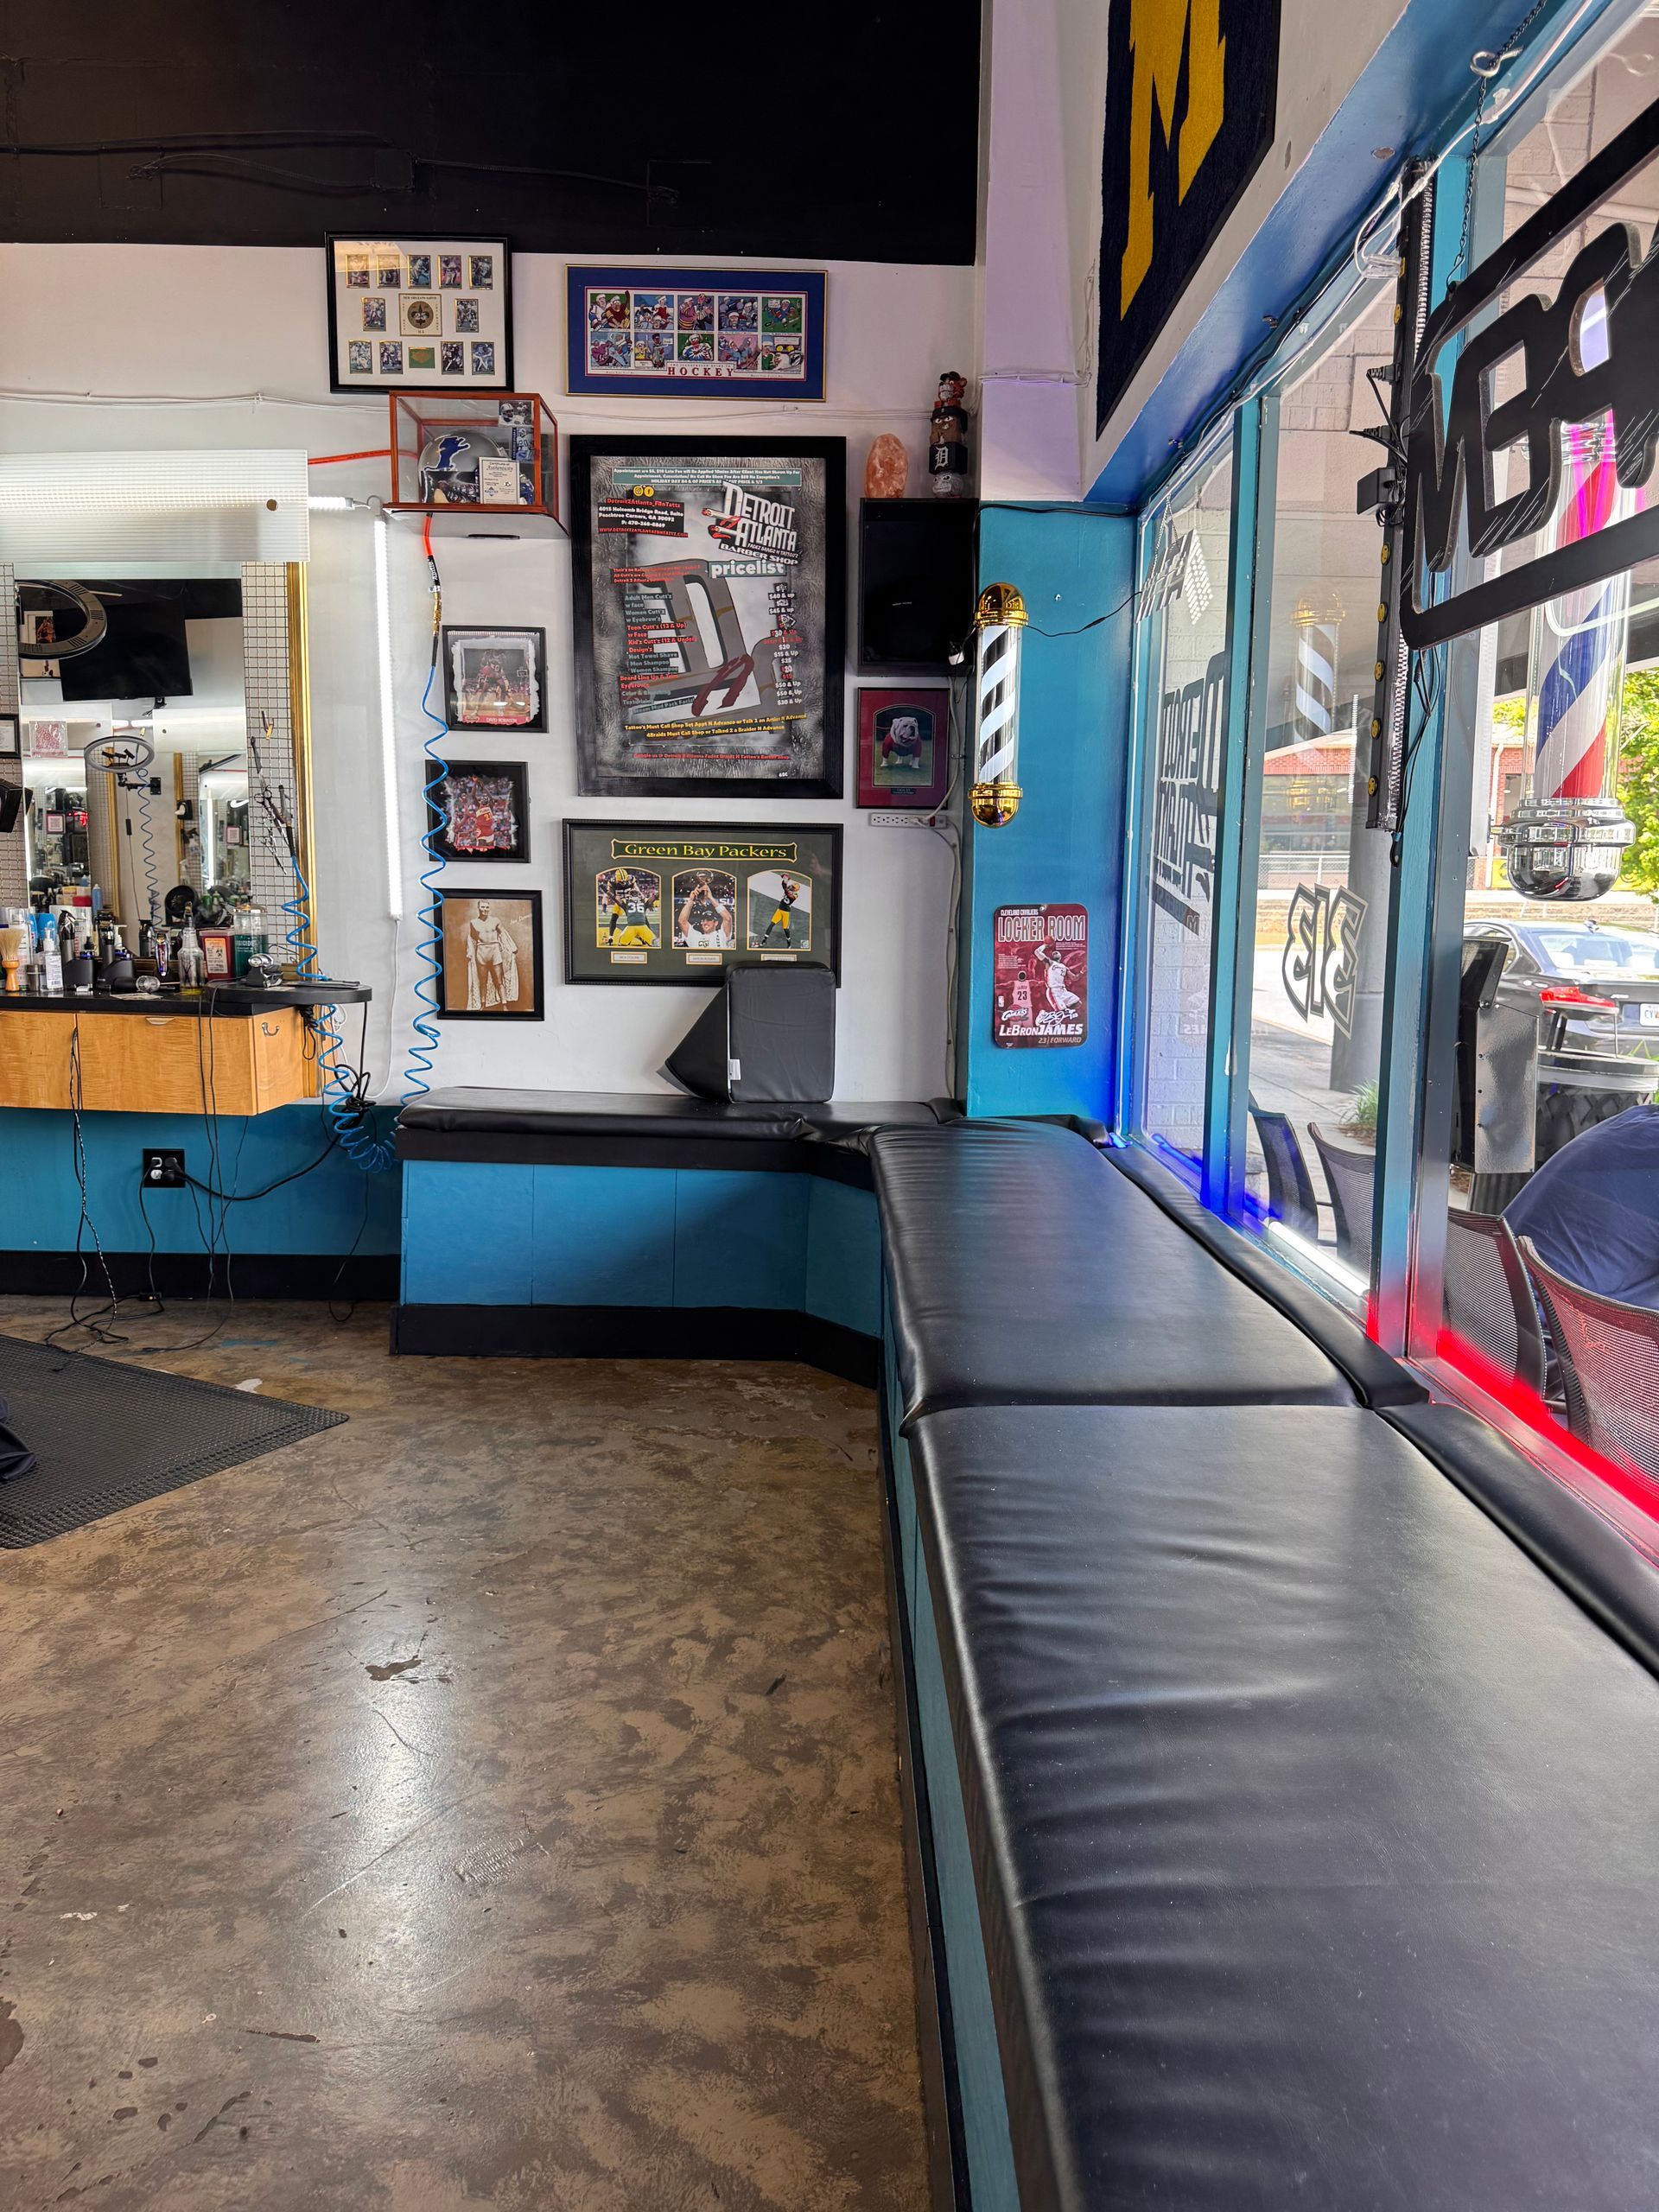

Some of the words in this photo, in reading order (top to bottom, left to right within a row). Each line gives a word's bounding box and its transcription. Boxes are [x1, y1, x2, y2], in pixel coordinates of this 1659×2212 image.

[667, 366, 734, 376] HOCKEY
[934, 445, 949, 470] D
[723, 481, 795, 529] DETROIT
[735, 518, 797, 552] ATLANTA
[720, 543, 767, 560] BARBER
[769, 556, 798, 565] SHOP
[711, 560, 784, 578] pricelist
[624, 843, 678, 855] Green
[683, 845, 715, 857] Bay
[720, 846, 787, 857] Packers
[628, 902, 644, 913] 36
[998, 916, 1044, 942] LOCKER
[1048, 915, 1086, 941] ROOM
[1017, 991, 1027, 1000] 23
